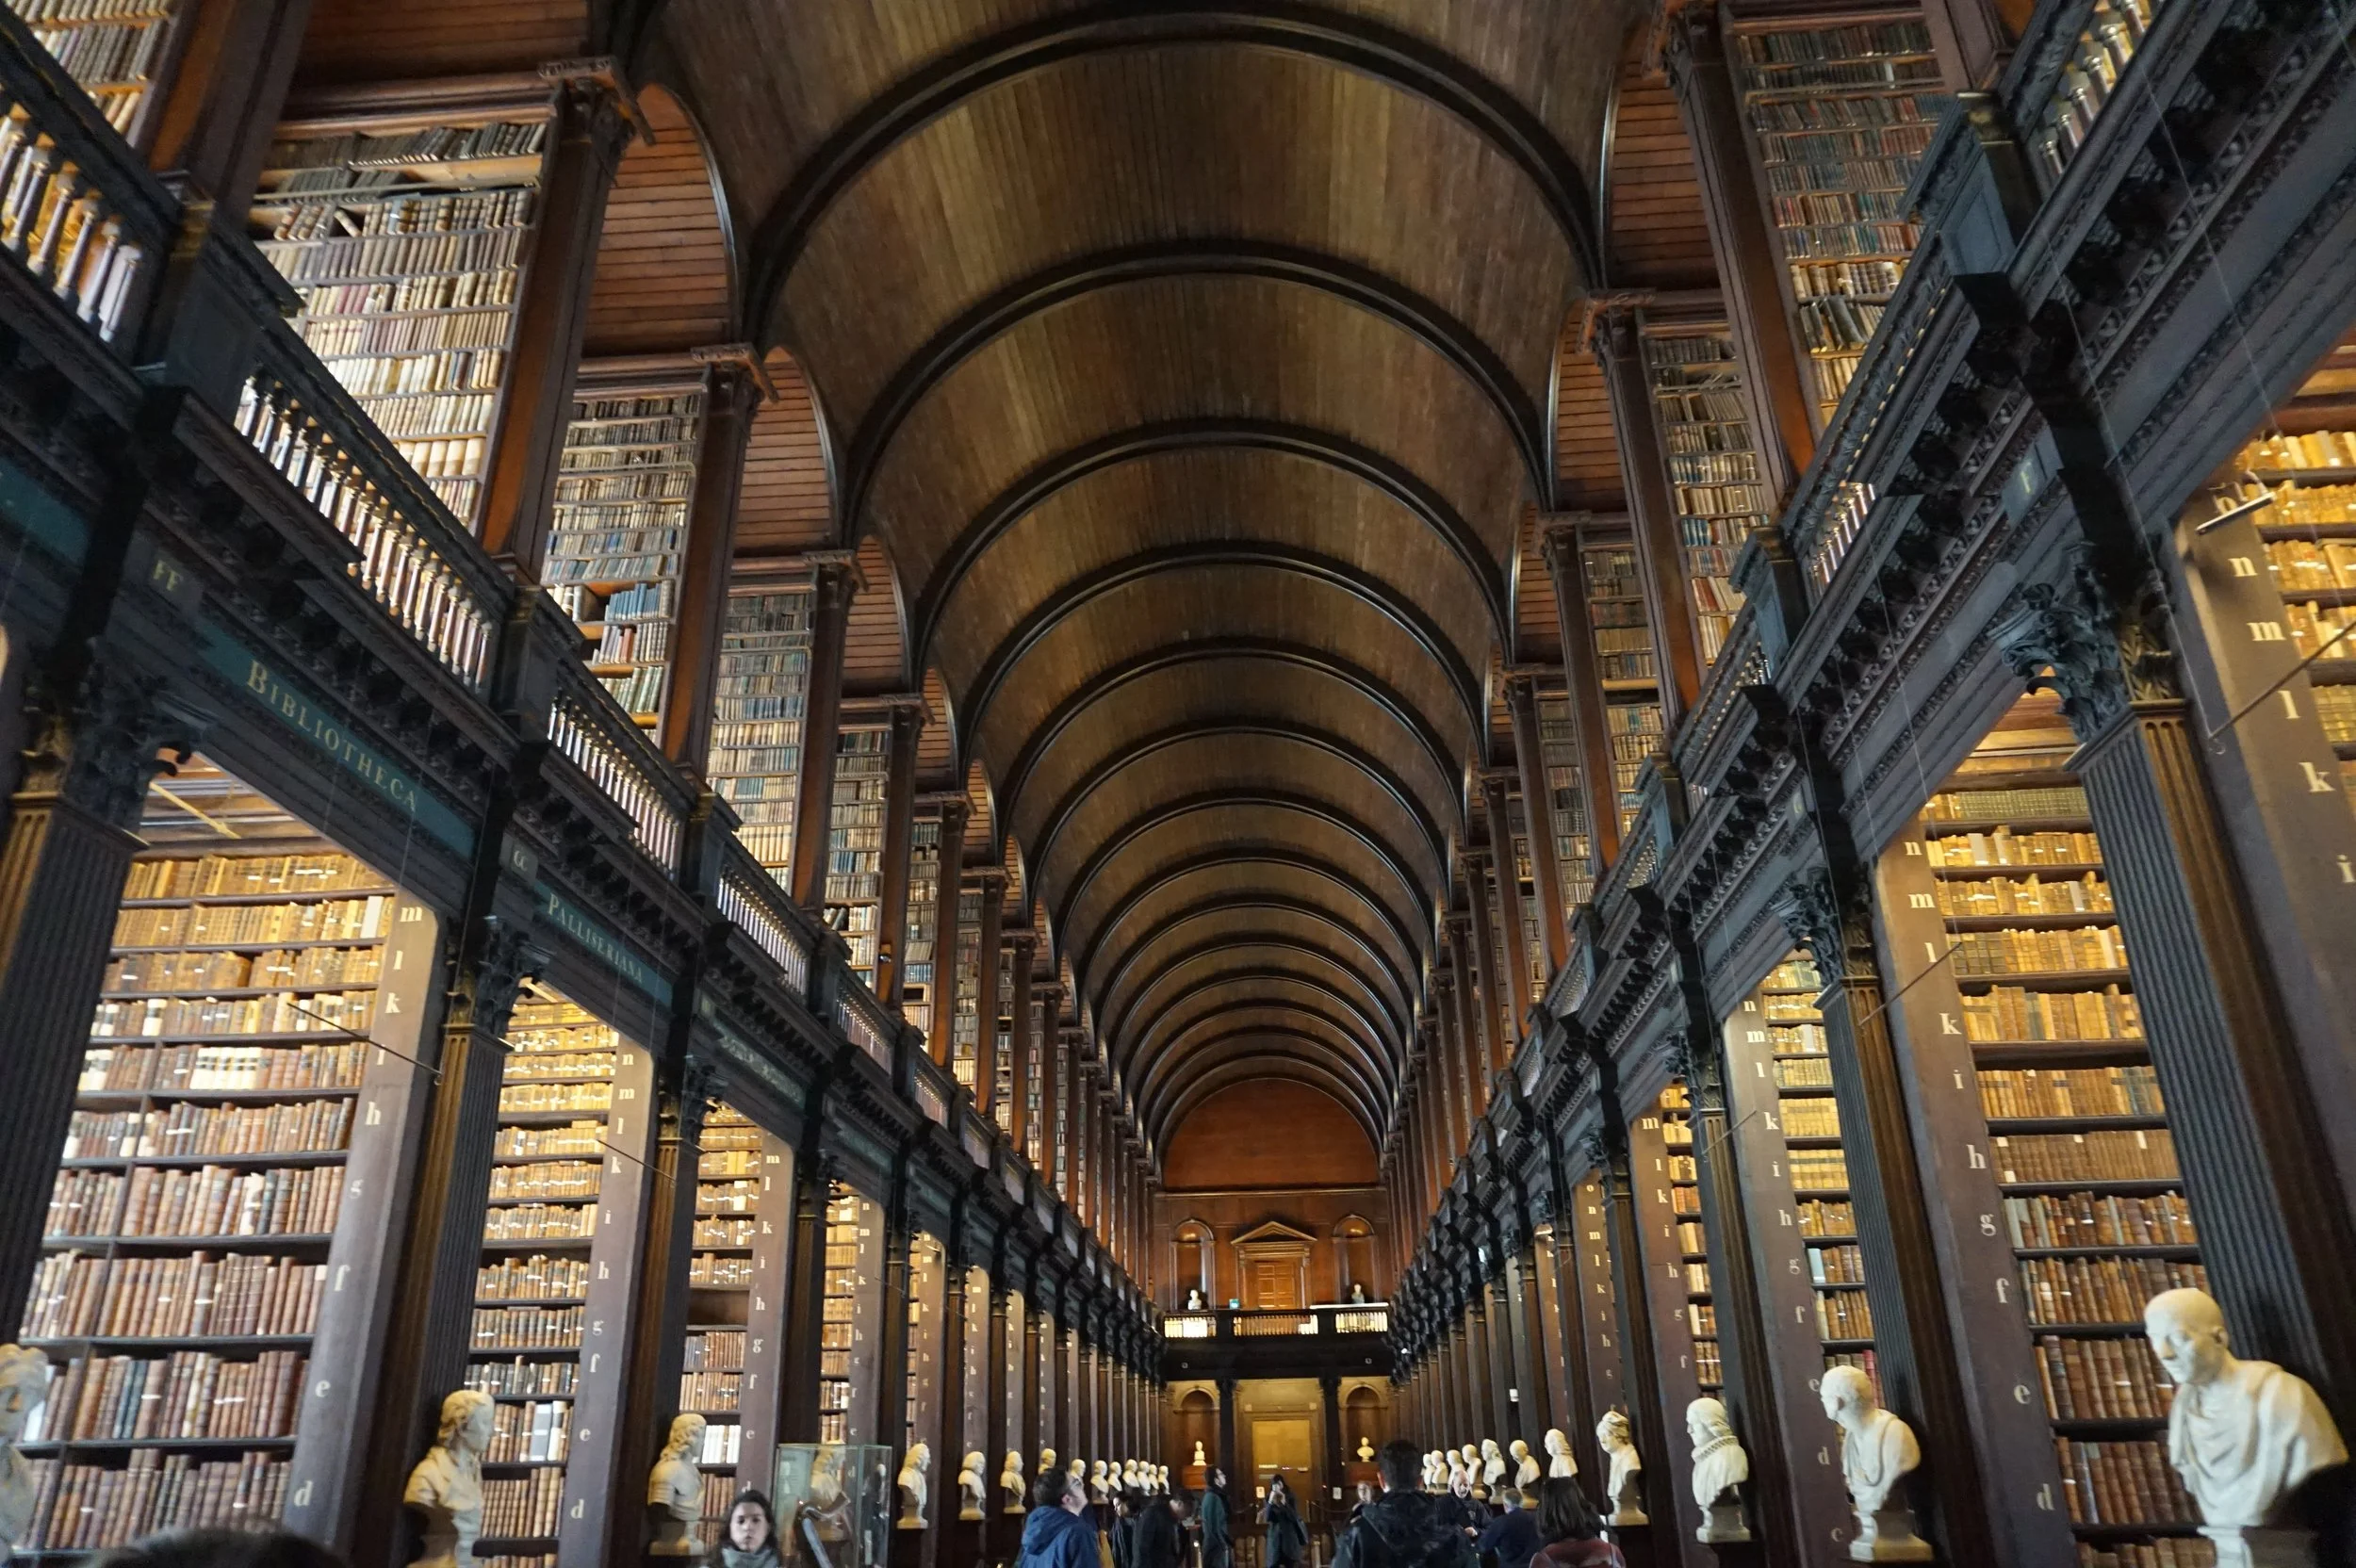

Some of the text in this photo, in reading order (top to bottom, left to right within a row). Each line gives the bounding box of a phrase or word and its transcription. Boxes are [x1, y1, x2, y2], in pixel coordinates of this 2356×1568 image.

[2228, 557, 2258, 578] n
[2246, 621, 2286, 642] m
[2277, 690, 2301, 719] l
[247, 659, 417, 814] BIBLIOTHECA
[2299, 761, 2336, 792] k
[1905, 841, 1922, 856] n
[2336, 854, 2355, 883] i
[1907, 893, 1936, 908] m
[400, 906, 423, 923] m
[393, 950, 403, 971] l
[1924, 942, 1938, 963] l
[384, 992, 401, 1014] k
[1743, 1000, 1757, 1012] n
[1939, 1012, 1962, 1035] k
[1746, 1029, 1765, 1043] m
[622, 1054, 634, 1066] n
[1755, 1062, 1765, 1078] l
[1953, 1070, 1965, 1089] i
[618, 1087, 635, 1100] m
[365, 1101, 382, 1125] h
[1763, 1111, 1779, 1130] k
[616, 1118, 623, 1135] l
[1641, 1117, 1661, 1130] m
[611, 1156, 622, 1174] k
[766, 1153, 780, 1164] m
[1655, 1158, 1662, 1171] l
[1967, 1144, 1987, 1169] h
[1772, 1161, 1780, 1177] i
[349, 1178, 364, 1199] g
[1657, 1188, 1668, 1203] k
[604, 1210, 611, 1224] i
[1778, 1209, 1792, 1226] h
[1980, 1213, 1997, 1236] g
[761, 1221, 773, 1234] k
[1663, 1224, 1671, 1237] i
[597, 1261, 610, 1280] h
[760, 1256, 766, 1268] i
[1666, 1262, 1678, 1278] h
[1789, 1258, 1801, 1275] g
[334, 1265, 351, 1291] f
[1995, 1278, 2010, 1304] f
[755, 1297, 765, 1311] h
[1794, 1305, 1806, 1324] f
[592, 1319, 604, 1336] g
[752, 1338, 763, 1353] g
[590, 1353, 600, 1373] f
[316, 1380, 331, 1397] e
[1808, 1378, 1821, 1393] e
[2013, 1384, 2031, 1405] e
[579, 1428, 591, 1442] e
[745, 1429, 755, 1440] e
[1817, 1446, 1831, 1465] d
[294, 1480, 314, 1507] d
[2037, 1483, 2055, 1511] d
[570, 1499, 585, 1519] d
